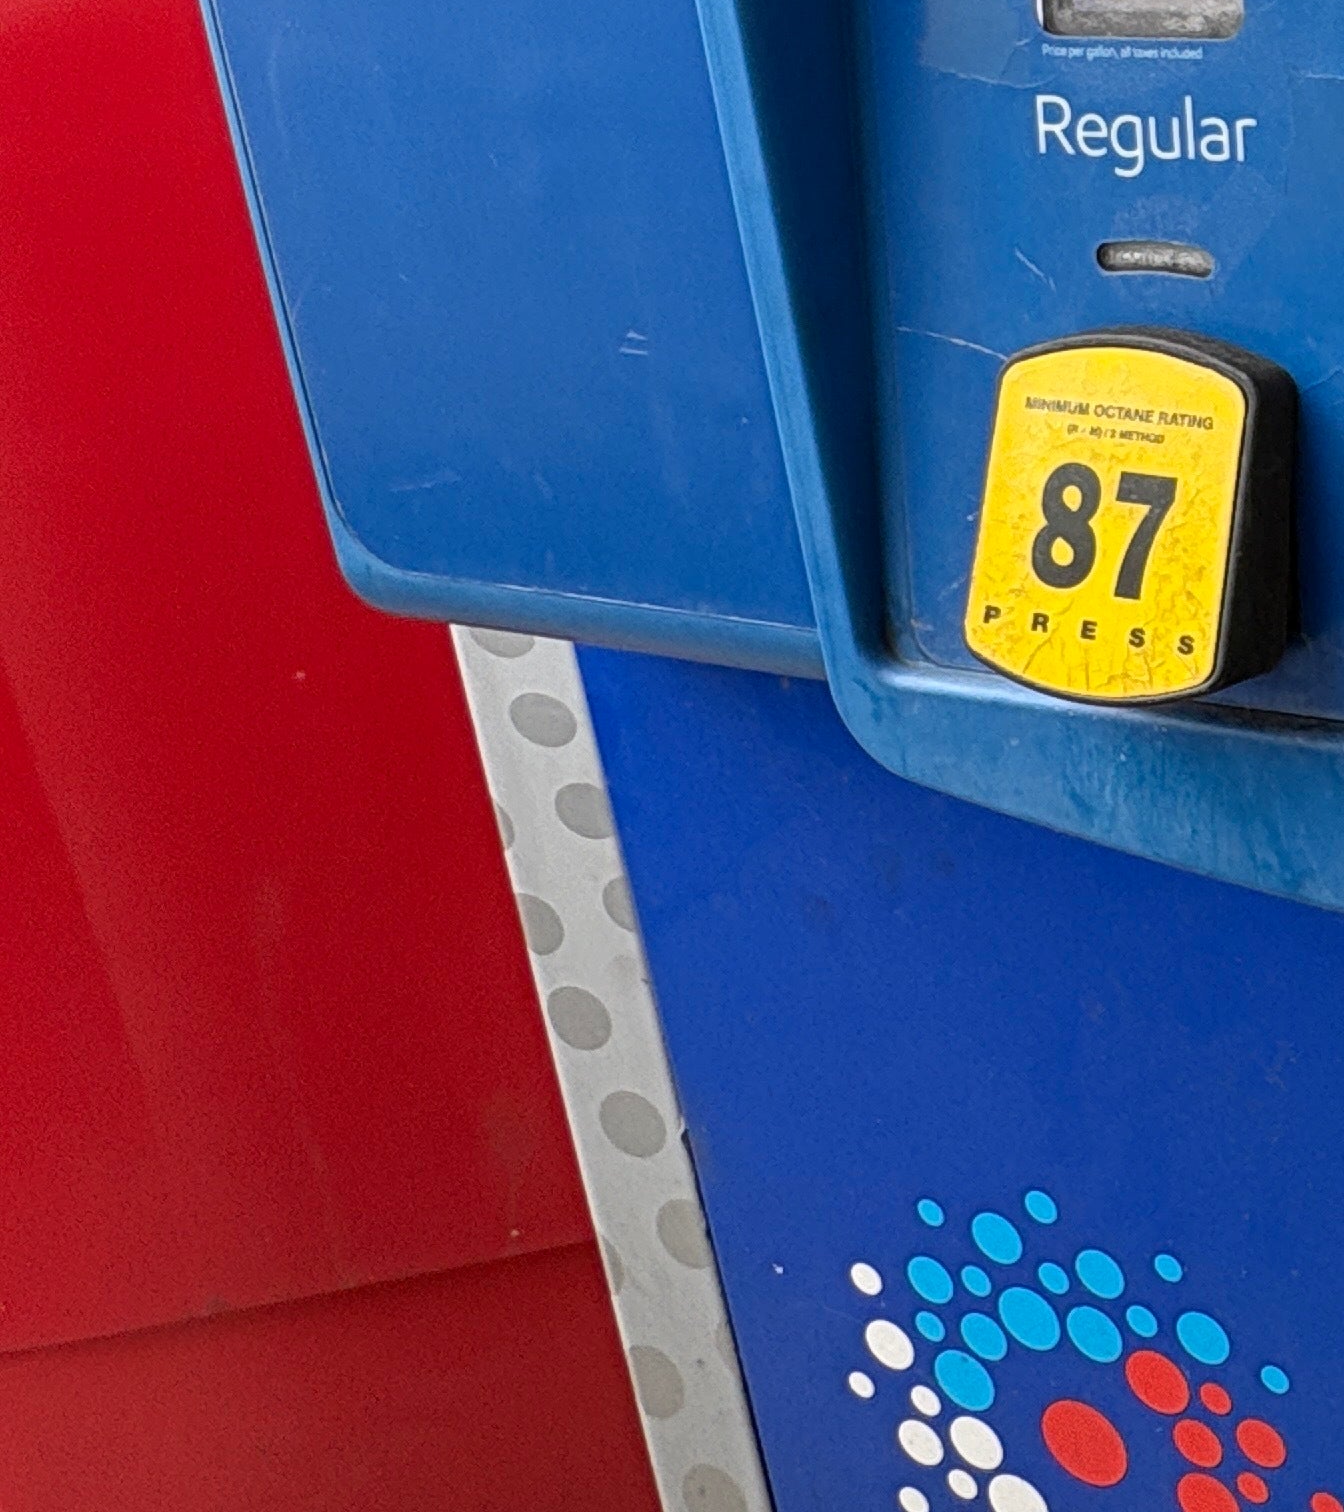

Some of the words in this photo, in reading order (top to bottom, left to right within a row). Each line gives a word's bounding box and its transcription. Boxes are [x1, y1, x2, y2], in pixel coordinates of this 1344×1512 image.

[1035, 94, 1258, 178] Regular
[1025, 396, 1090, 416] MINIMUM
[1094, 404, 1155, 424] OCTANE
[1157, 411, 1214, 430] RATING
[1119, 430, 1165, 444] METHOD
[1031, 462, 1178, 600] 87
